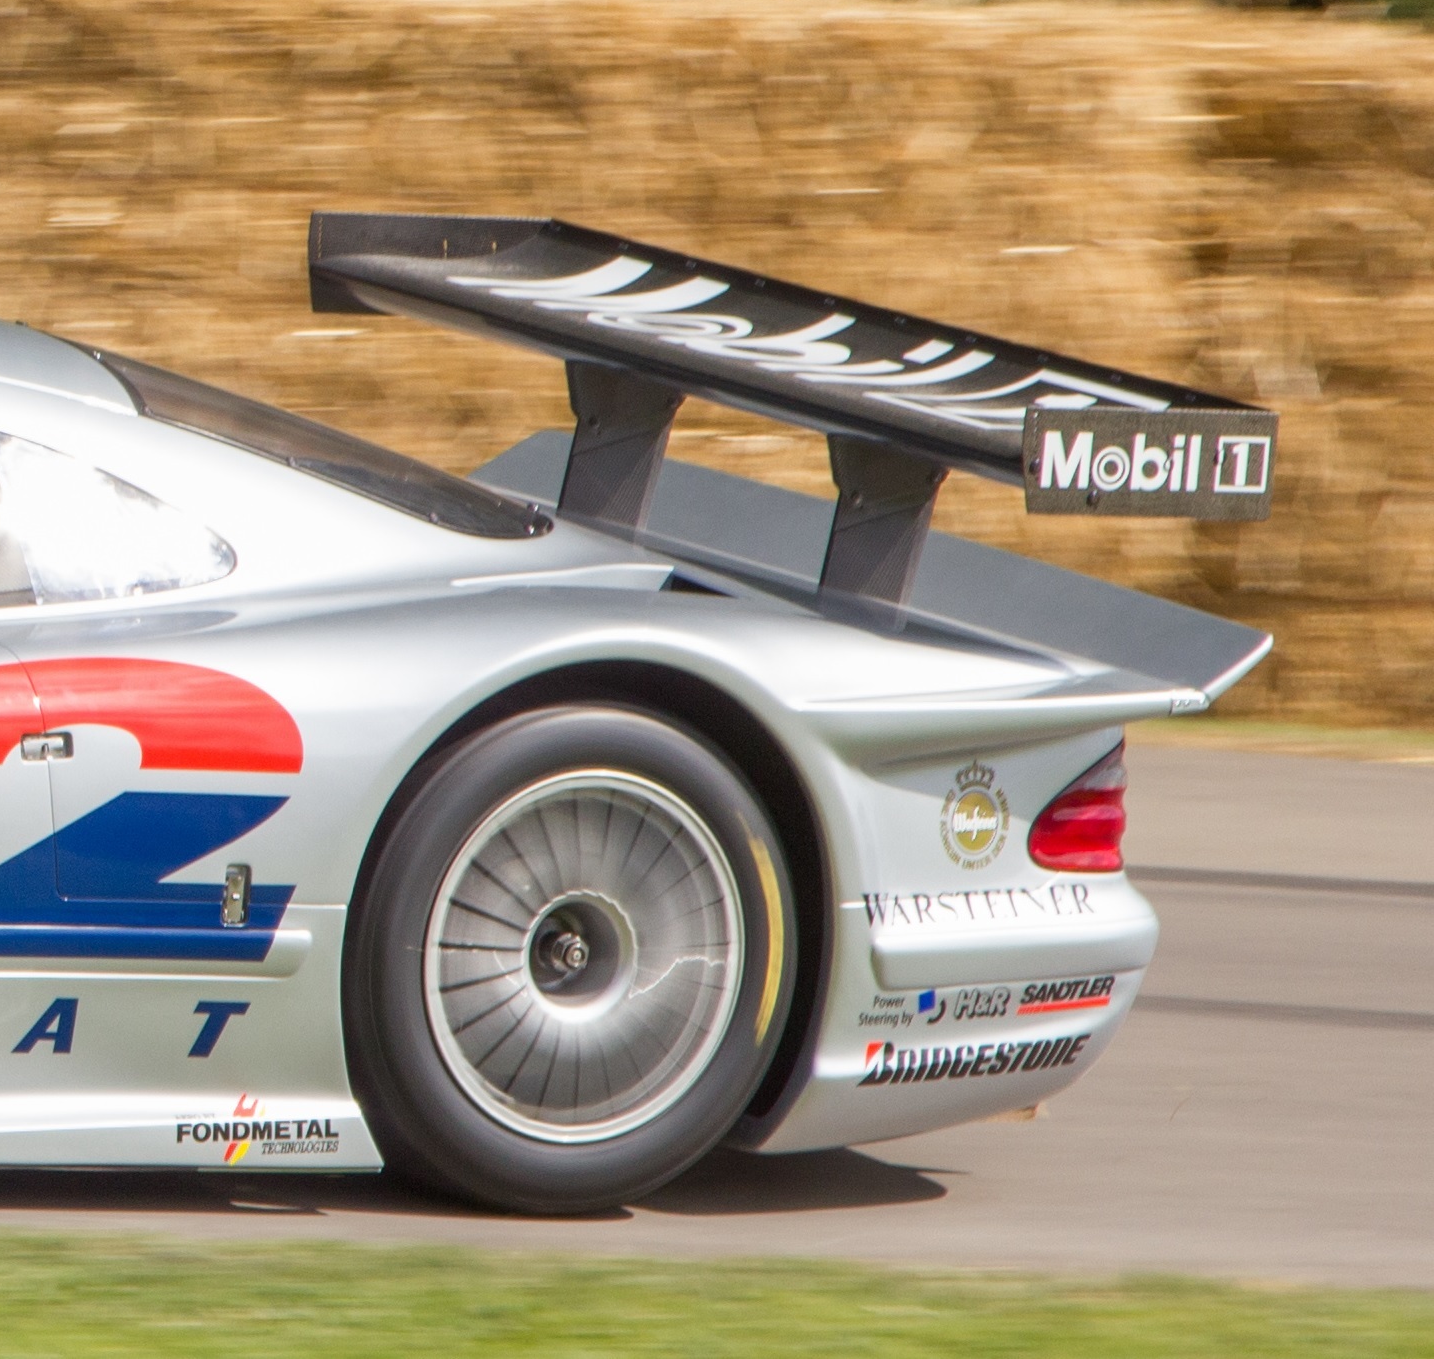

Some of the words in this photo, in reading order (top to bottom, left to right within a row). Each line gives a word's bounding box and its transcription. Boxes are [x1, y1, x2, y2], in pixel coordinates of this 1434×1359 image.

[1040, 430, 1202, 492] Mobil
[862, 883, 1095, 930] WARSTEINER
[872, 994, 906, 1009] Power
[953, 986, 1012, 1020] H&R
[1020, 976, 1116, 1005] SANDTLER
[858, 1012, 900, 1027] Steering
[901, 1011, 914, 1028] by
[857, 1033, 1092, 1088] BRIDGESTONE
[176, 1119, 339, 1143] FONDMETAL
[261, 1141, 340, 1156] TECHNOLOGIES
